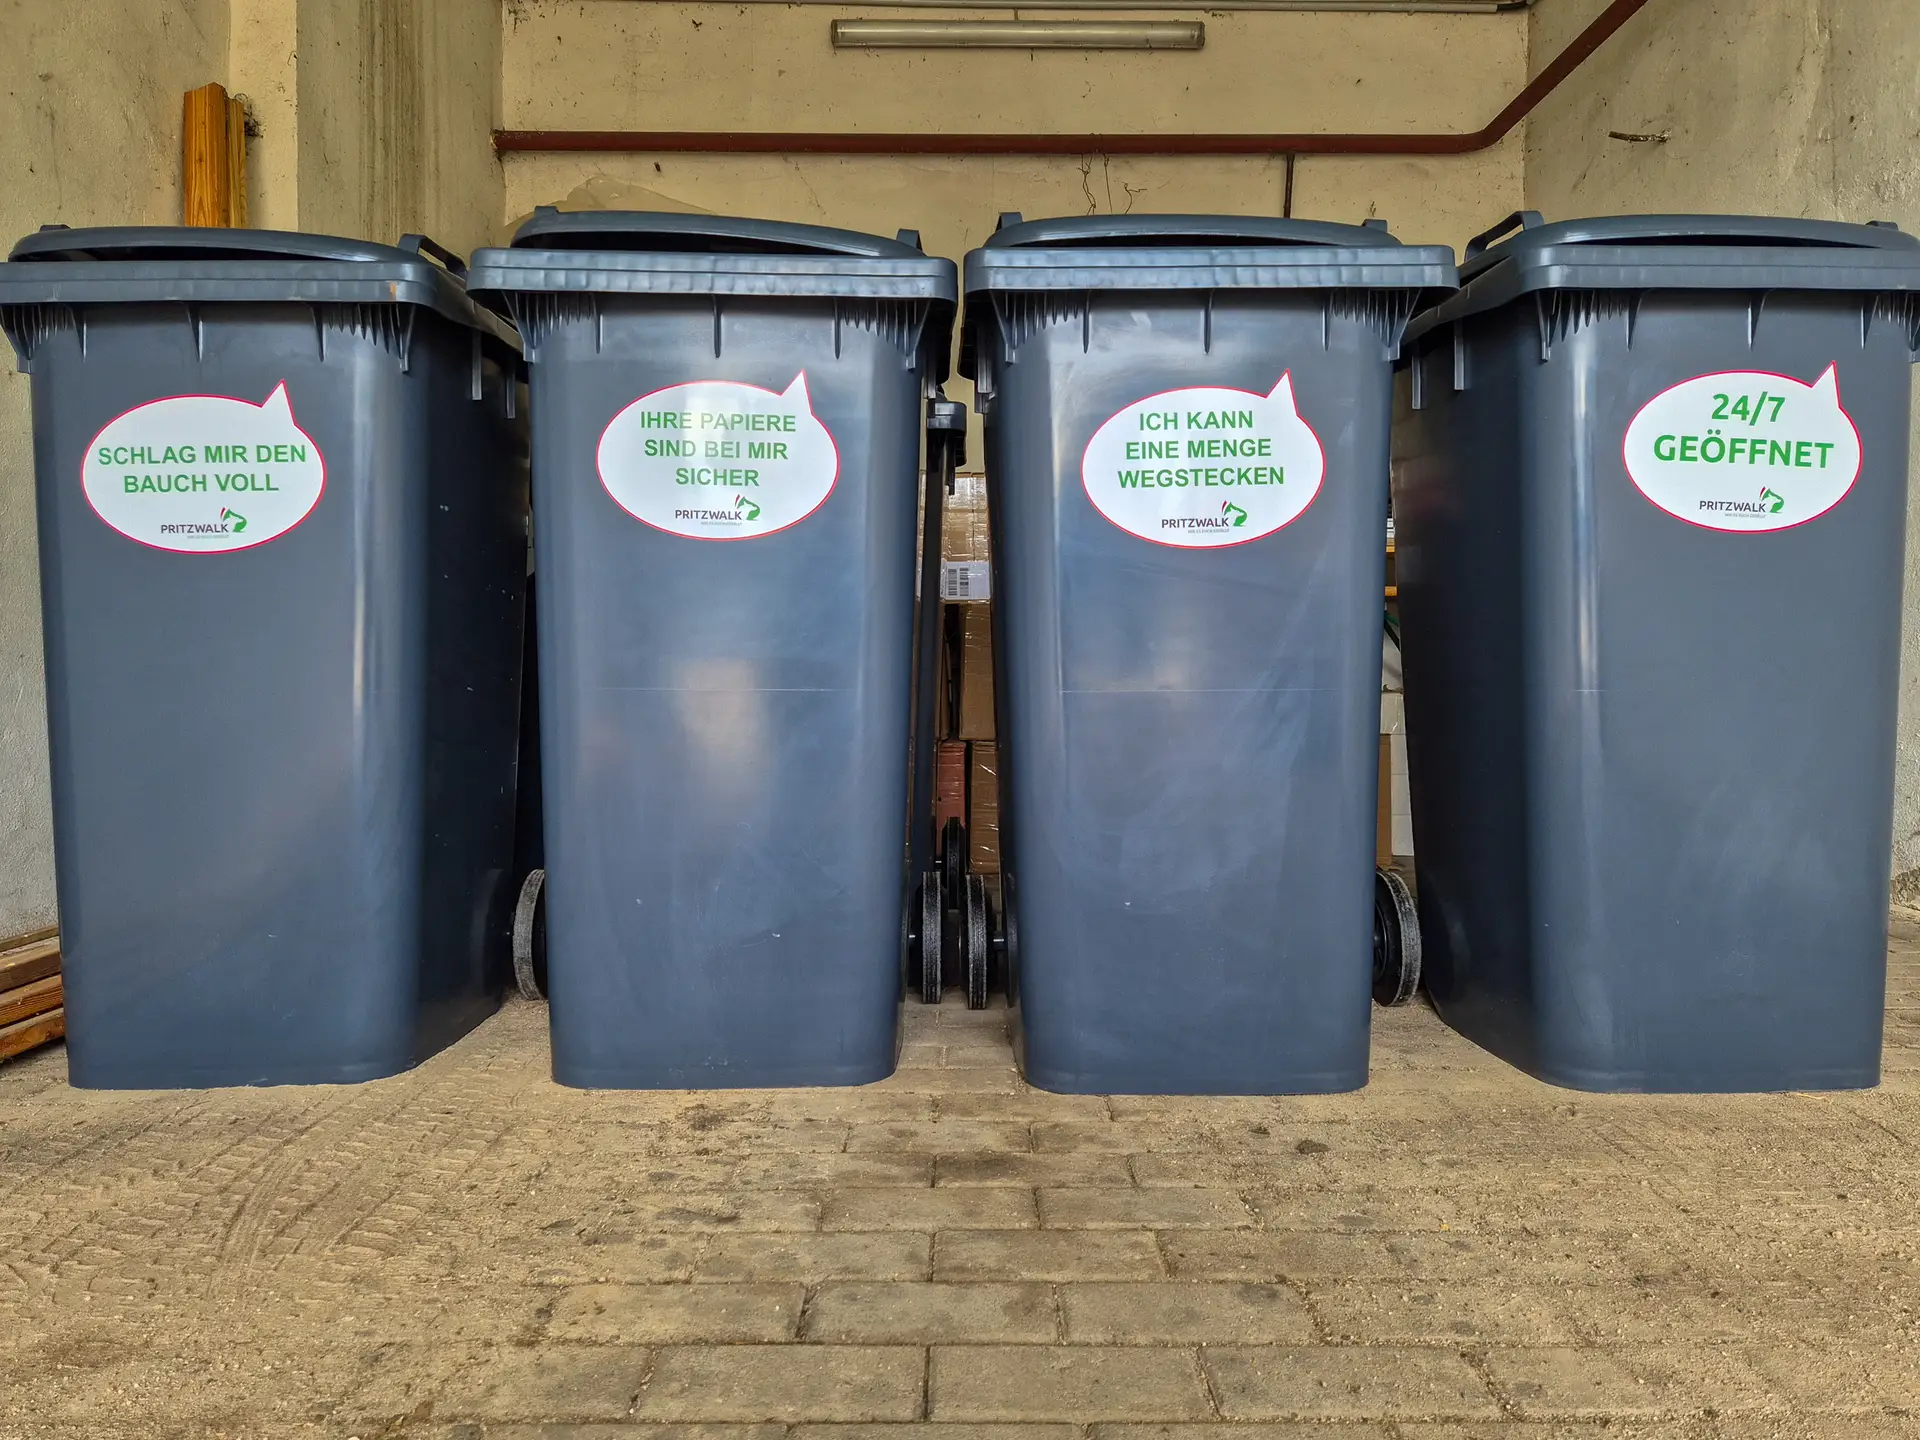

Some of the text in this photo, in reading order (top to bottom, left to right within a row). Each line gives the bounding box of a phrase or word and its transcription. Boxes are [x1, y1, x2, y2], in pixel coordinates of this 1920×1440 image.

[1711, 391, 1786, 427] 24/7
[640, 411, 796, 432] IHRE PAPIERE
[1139, 410, 1254, 431] ICH KANN
[98, 443, 308, 467] SCHLAG MIR DEN
[644, 439, 788, 460] SIND BEI MIR
[1125, 437, 1272, 460] EINE MENGE
[1653, 429, 1836, 470] GEÖFFNET
[122, 472, 280, 494] BAUCH VOLL
[675, 467, 760, 487] SICHER
[1117, 465, 1286, 489] WEGSTECKEN
[675, 509, 742, 521] PRITZWALK
[1699, 500, 1766, 513] PRITZWALK
[160, 523, 229, 534] PRITZWALK
[1161, 517, 1229, 529] PRITZWALK
